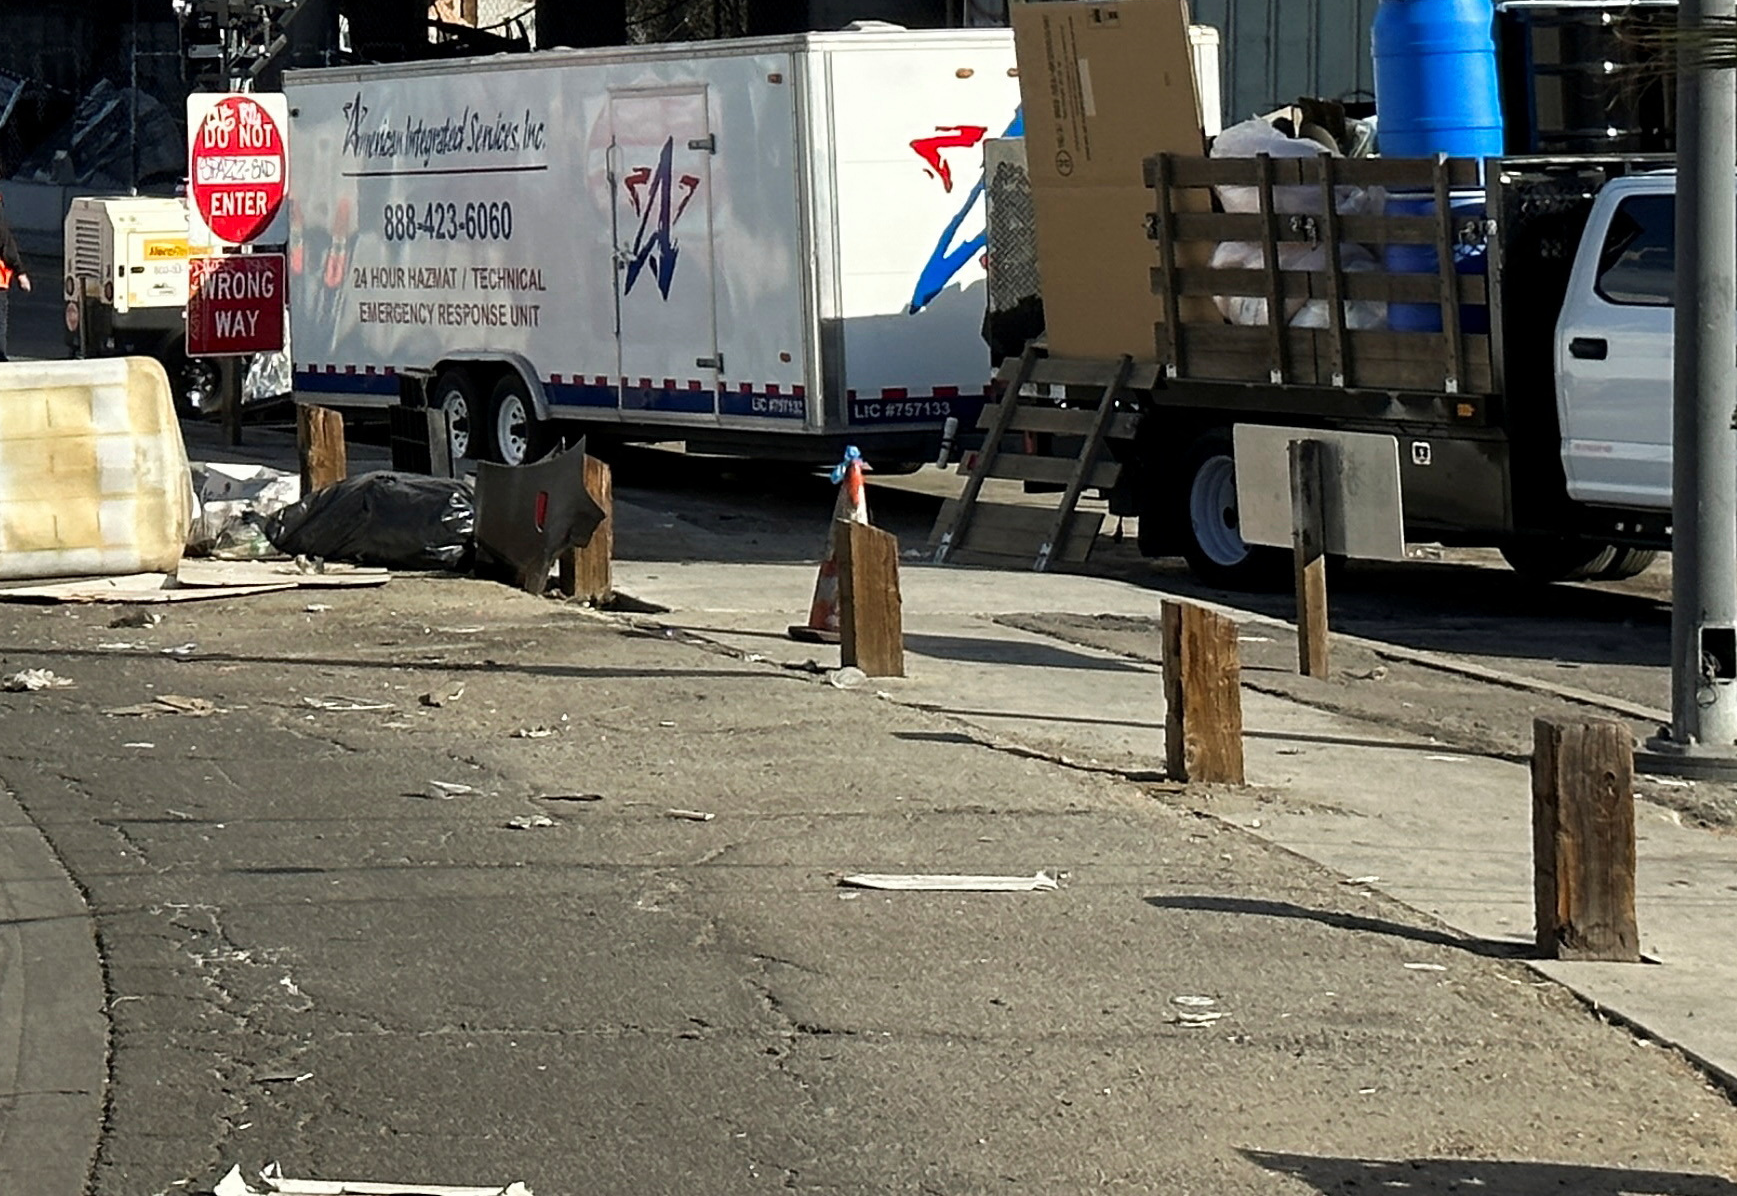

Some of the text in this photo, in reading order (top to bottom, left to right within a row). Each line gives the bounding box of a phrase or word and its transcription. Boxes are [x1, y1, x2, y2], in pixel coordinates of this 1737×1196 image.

[204, 123, 274, 149] DO NOT
[342, 91, 403, 159] American
[404, 105, 470, 168] Integrated
[522, 108, 548, 151] Inc.
[210, 191, 268, 216] ENTER
[383, 201, 513, 242] 888-423-6060
[200, 270, 275, 300] WRONG
[353, 267, 368, 290] 24
[371, 267, 405, 290] HOUR
[408, 267, 458, 290] HAZMAT
[471, 267, 548, 292] TECHNICAL
[215, 309, 260, 339] WAY
[359, 301, 541, 328] EMERGENCY RESPONSE UNIT
[853, 401, 952, 419] LIC #757133
